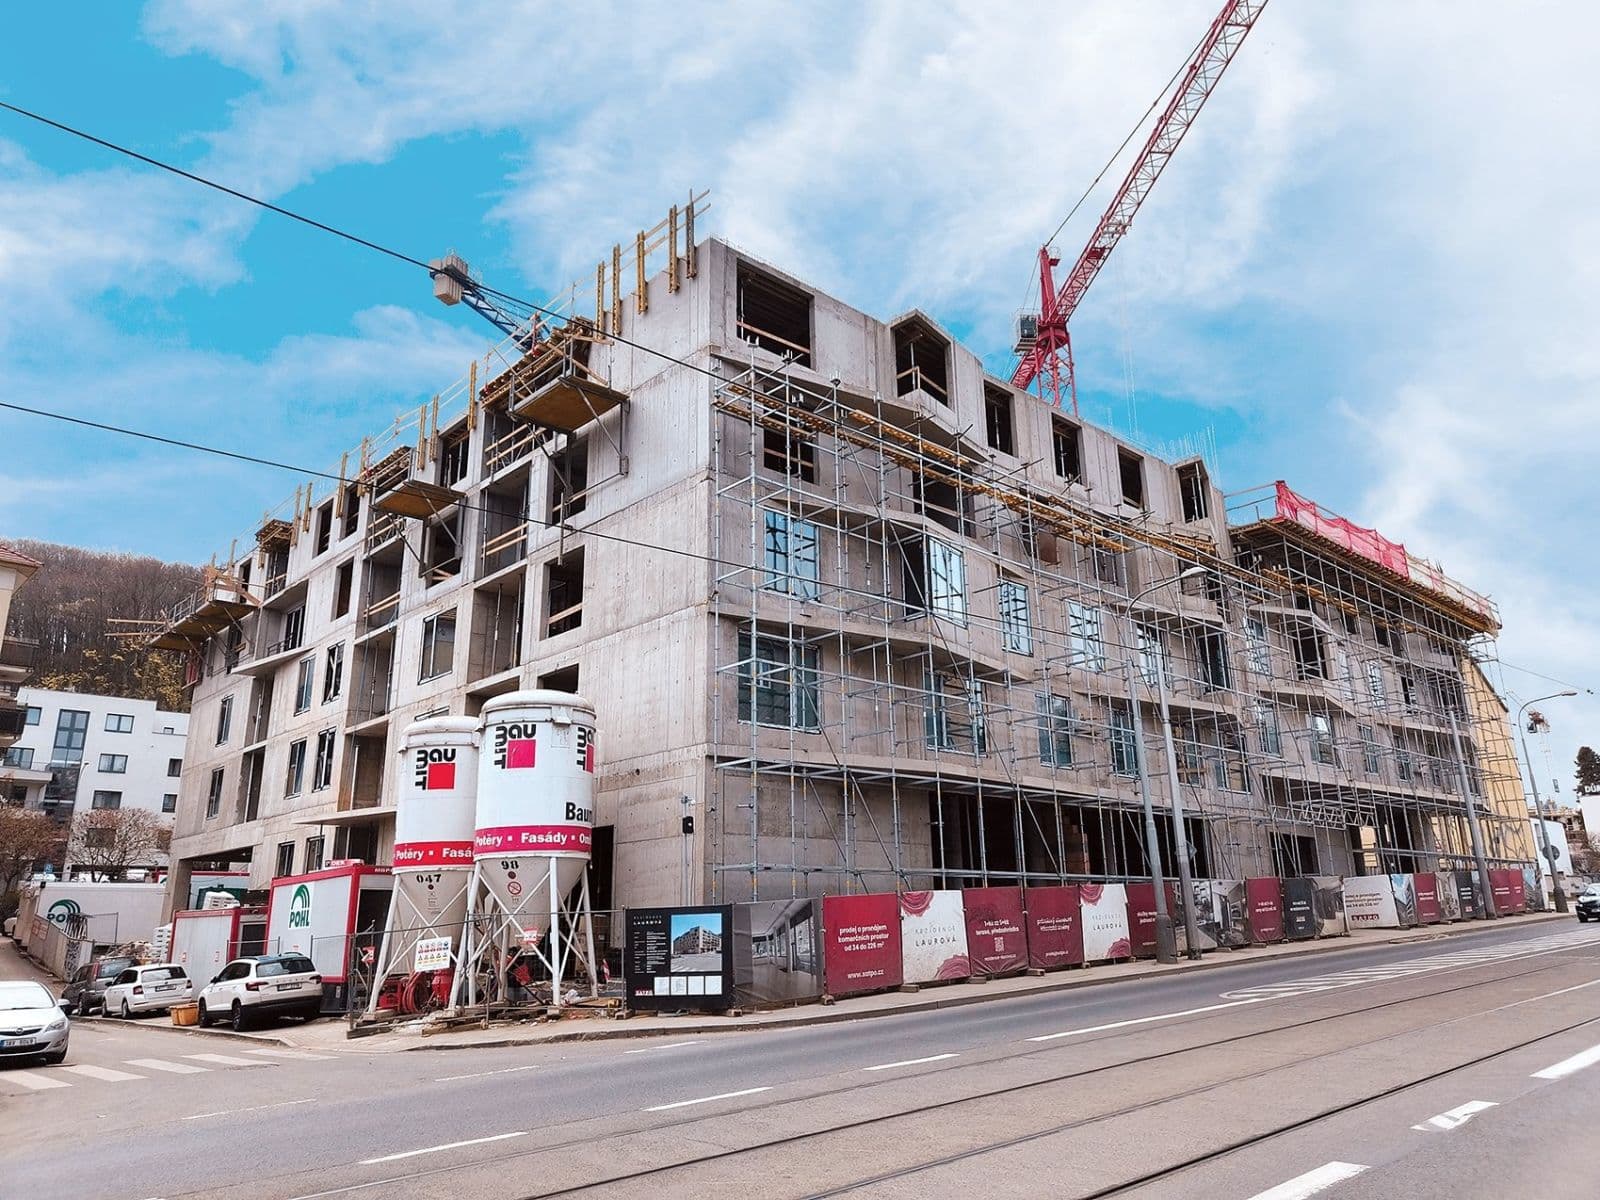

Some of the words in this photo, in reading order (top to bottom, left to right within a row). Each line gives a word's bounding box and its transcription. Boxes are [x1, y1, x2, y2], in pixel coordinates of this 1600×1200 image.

[521, 830, 568, 845] Fasády
[442, 846, 474, 858] Fasá
[289, 909, 310, 929] POHL
[870, 933, 889, 942] prostor
